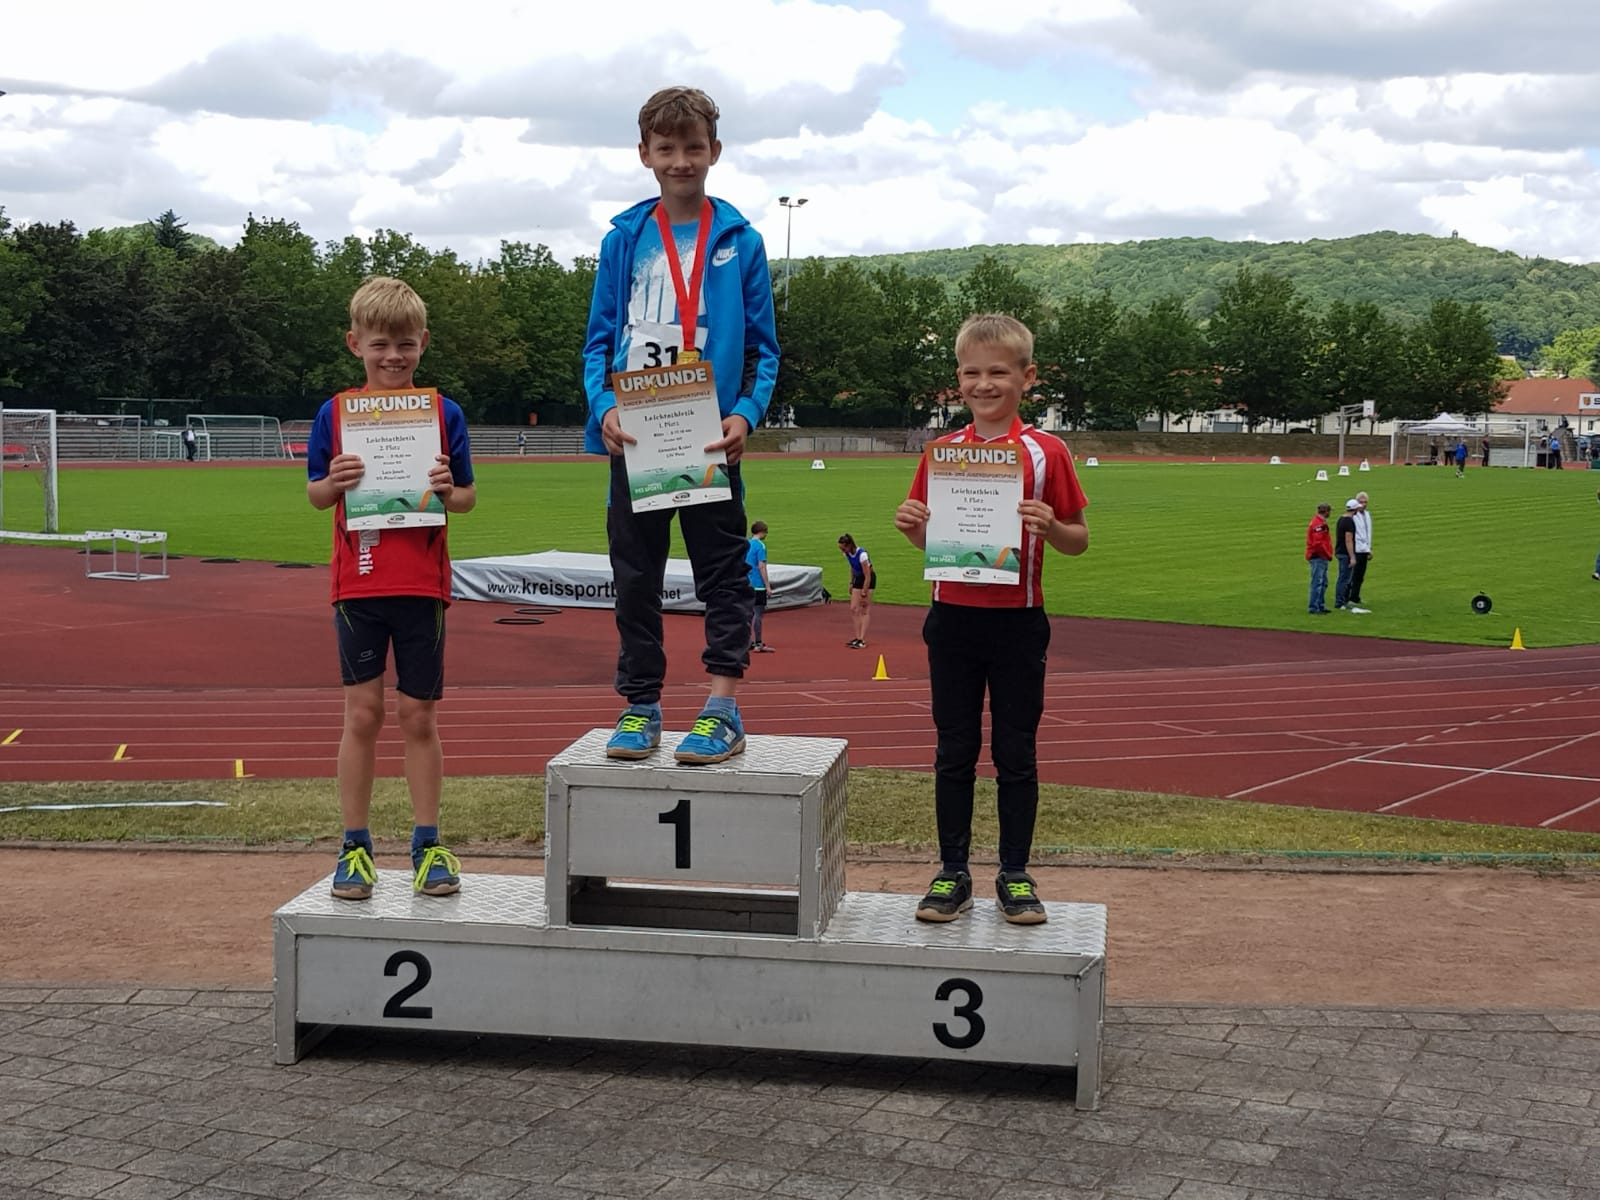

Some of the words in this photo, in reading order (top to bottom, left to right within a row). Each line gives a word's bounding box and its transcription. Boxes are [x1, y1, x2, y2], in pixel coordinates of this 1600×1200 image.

[620, 368, 707, 392] URKUNDE
[345, 395, 432, 413] URKUNDE
[933, 447, 1017, 464] URKUNDE
[658, 799, 692, 869] 1
[382, 950, 434, 1019] 2
[932, 977, 986, 1049] 3
